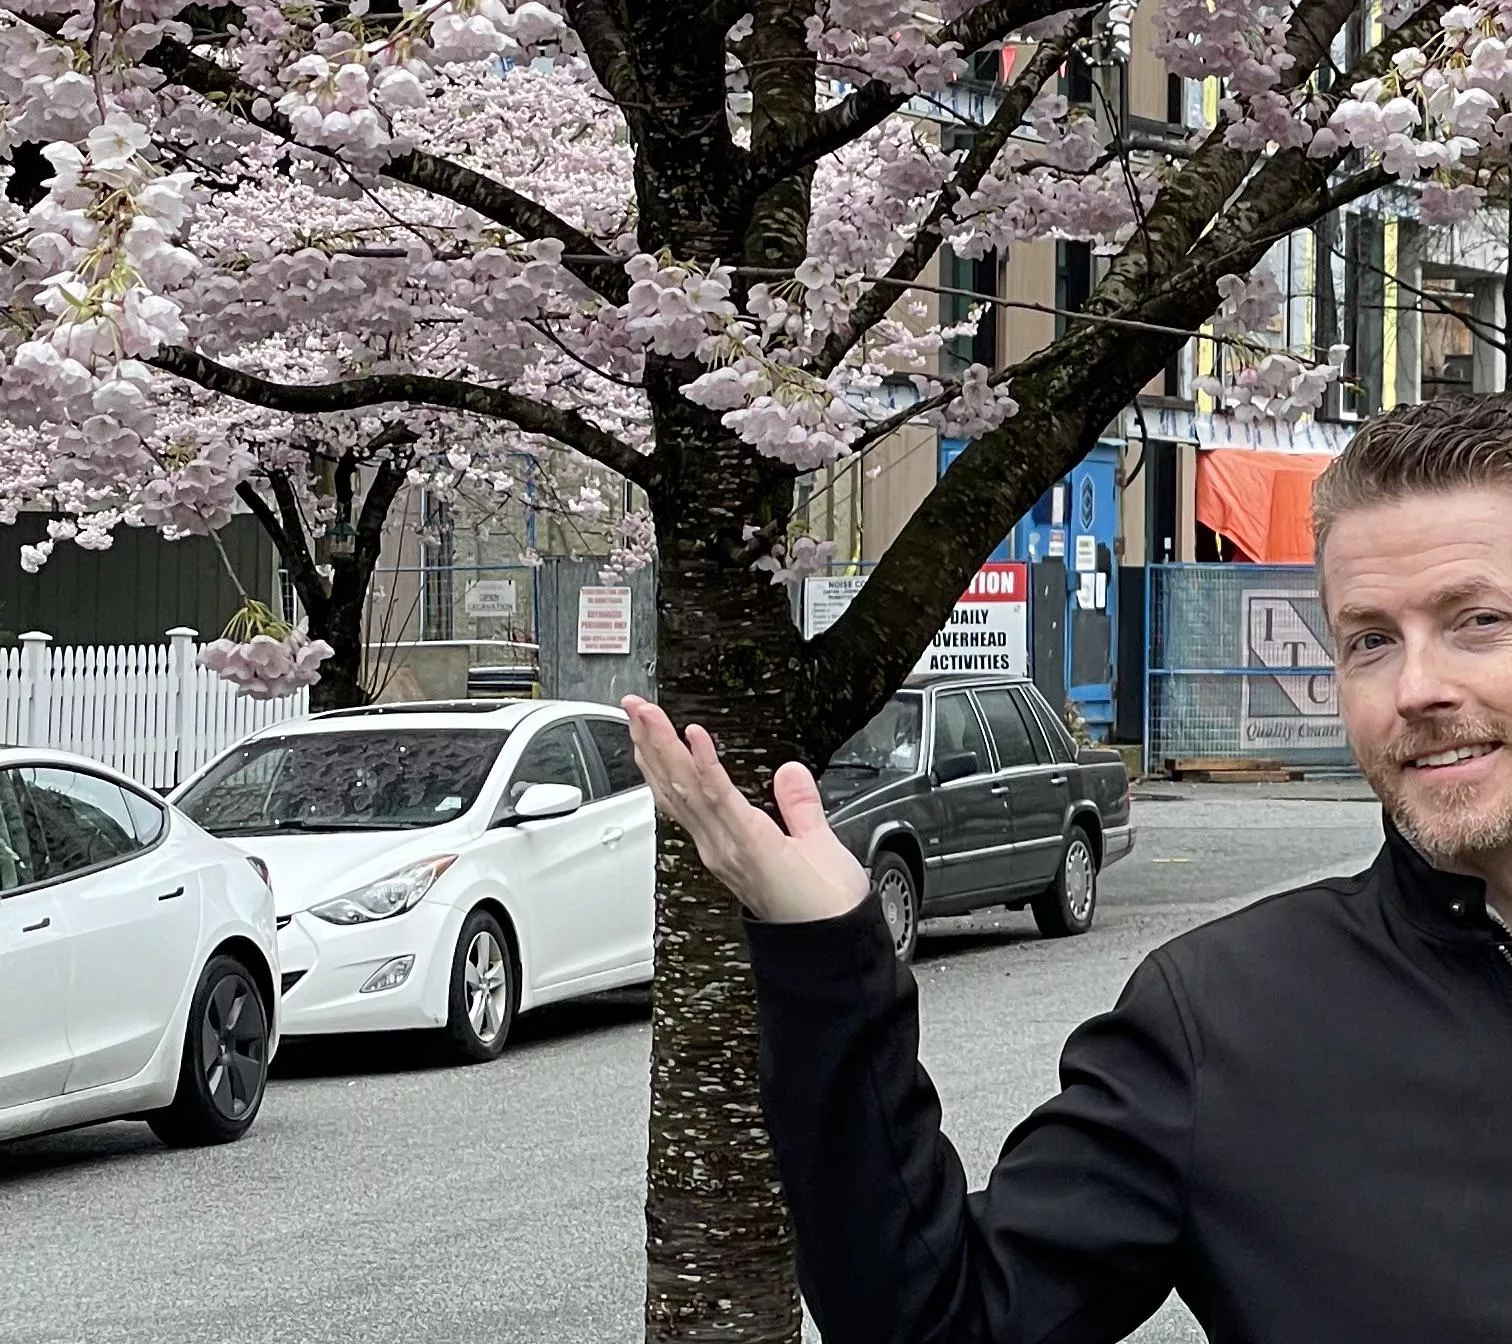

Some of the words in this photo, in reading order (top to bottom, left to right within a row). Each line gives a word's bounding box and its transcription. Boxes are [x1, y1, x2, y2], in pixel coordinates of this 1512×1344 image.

[950, 609, 989, 625] DAILY
[932, 632, 1007, 648] OVERHEAD
[930, 654, 1010, 670] ACTIVITIES
[1246, 722, 1291, 742] Quality
